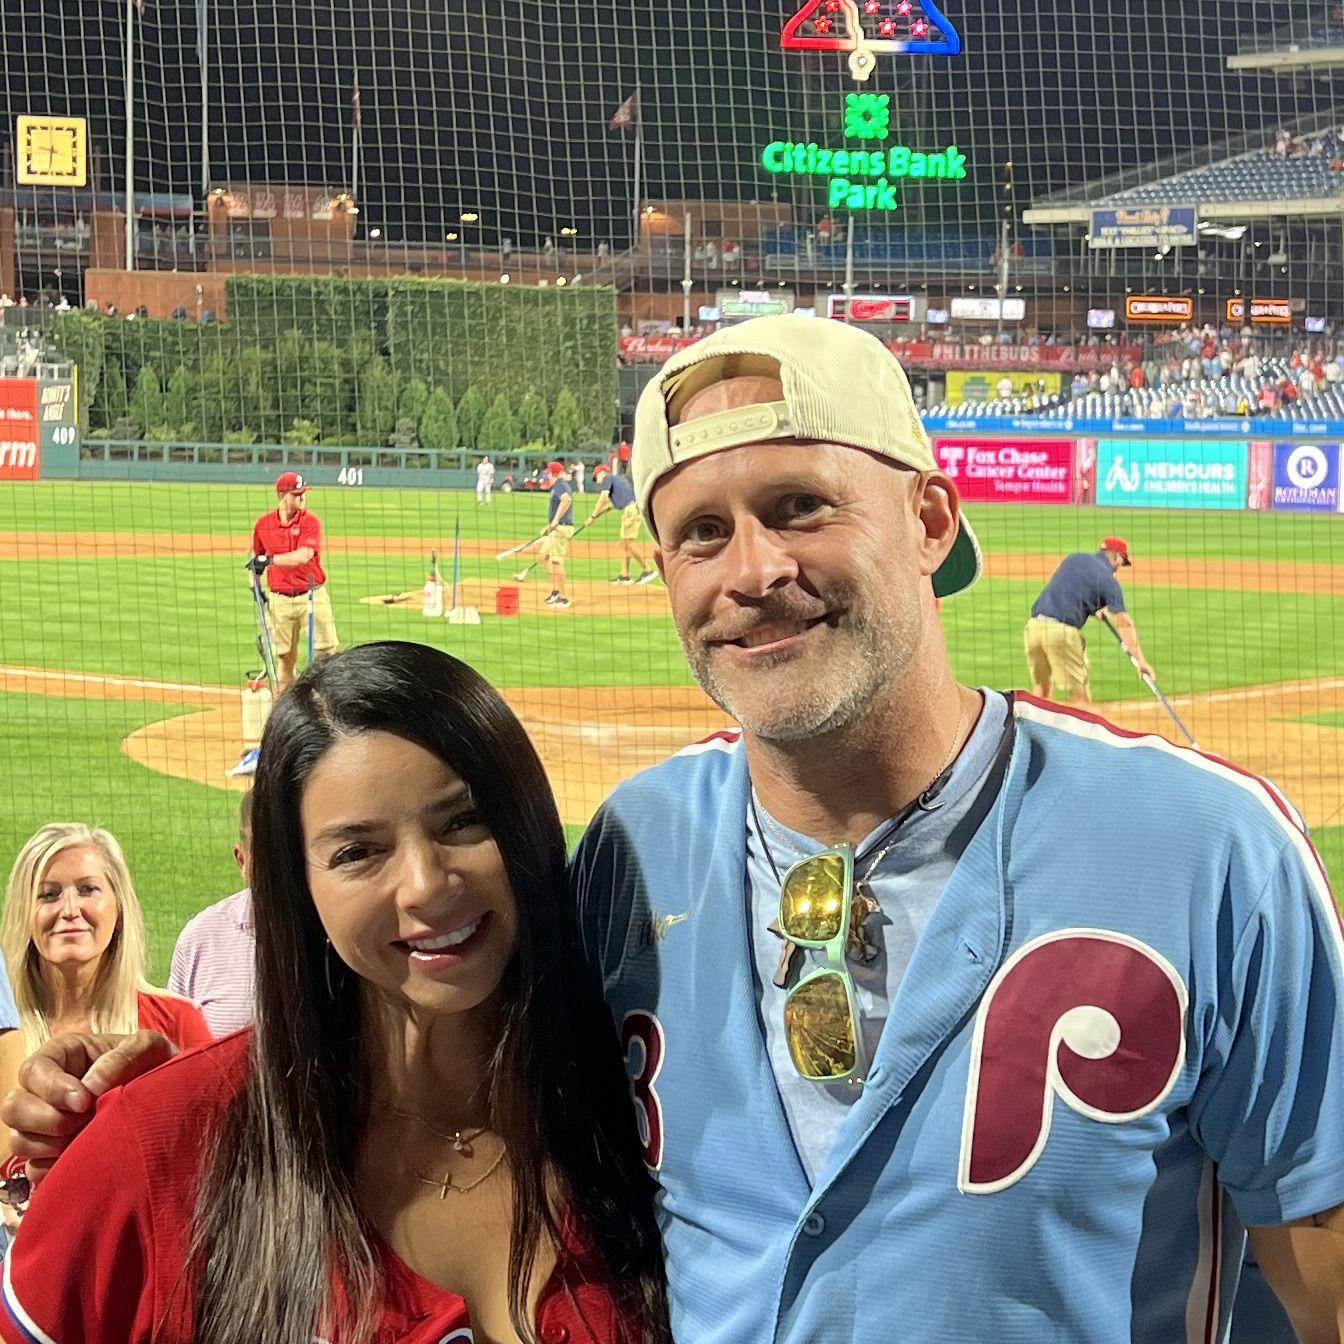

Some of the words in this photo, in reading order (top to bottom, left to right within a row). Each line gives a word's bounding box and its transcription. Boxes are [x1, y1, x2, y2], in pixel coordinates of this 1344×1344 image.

[762, 140, 886, 177] Citizens
[889, 145, 967, 180] Bank
[828, 177, 897, 211] Park
[52, 427, 76, 445] 409
[966, 447, 995, 464] Fox
[998, 447, 1049, 464] Chase
[338, 467, 364, 486] 401
[965, 464, 1016, 478] Cancer
[1017, 464, 1068, 479] Center
[1144, 462, 1236, 481] NEMOURS
[957, 928, 1188, 1196] P
